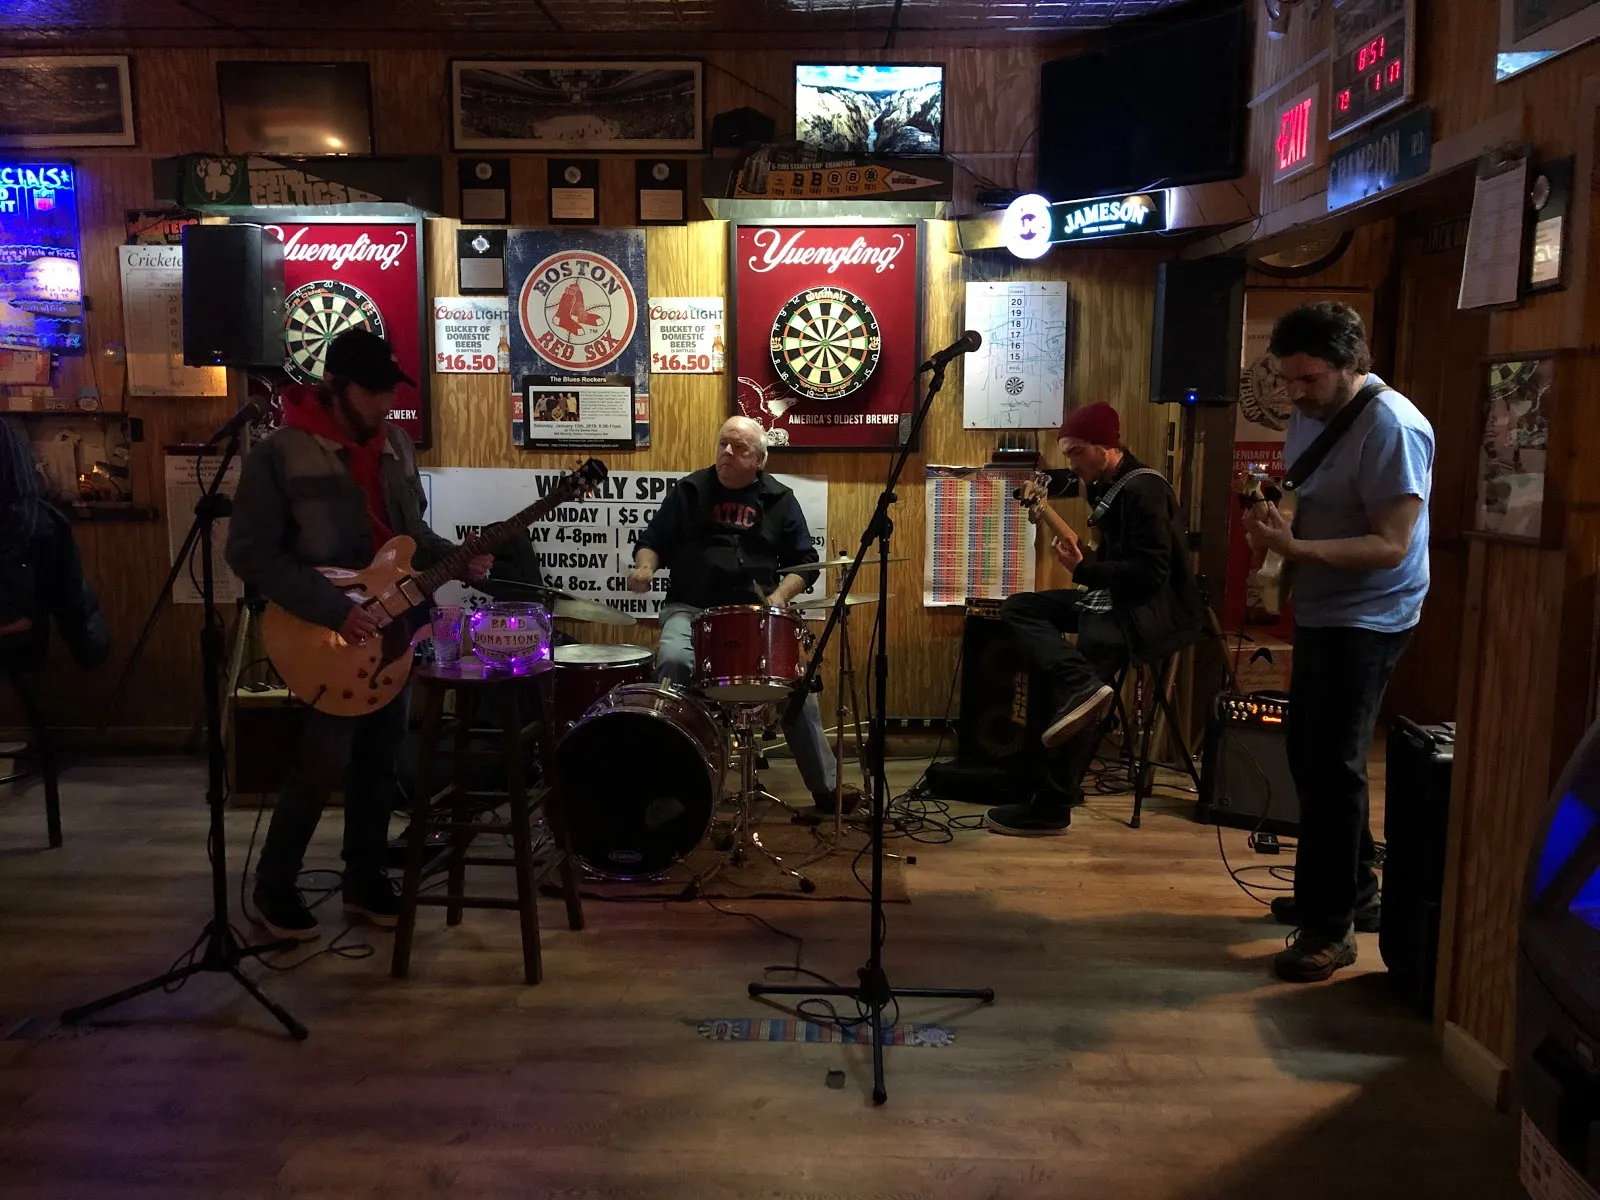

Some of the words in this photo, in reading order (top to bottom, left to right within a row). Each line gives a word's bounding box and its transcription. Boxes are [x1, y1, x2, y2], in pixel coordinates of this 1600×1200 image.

[1279, 97, 1312, 170] EXIT
[0, 167, 61, 187] CIALS
[251, 182, 349, 208] CELTICS
[1064, 201, 1148, 234] JAMESON
[533, 260, 622, 297] BOSTON
[1011, 298, 1023, 306] 20
[434, 305, 474, 321] Coors
[475, 310, 509, 320] LIGHT
[649, 305, 688, 321] Coors
[690, 310, 723, 320] LIGHT
[1011, 309, 1022, 318] 19
[445, 325, 478, 333] BUCKET
[479, 325, 491, 333] OF
[660, 325, 692, 333] BUCKET
[694, 325, 706, 333] OF
[1011, 320, 1022, 328] 18
[446, 333, 490, 341] DOMESTIC
[661, 333, 705, 341] DOMESTIC
[1010, 331, 1021, 339] 17
[455, 341, 482, 349] BEERS
[537, 330, 575, 361] RED
[583, 329, 620, 361] SOX
[670, 341, 697, 349] BEERS
[1011, 343, 1021, 351] 16
[437, 351, 496, 371] $16.50
[652, 351, 710, 371] $16.50
[1010, 353, 1021, 361] 15
[563, 376, 580, 384] Blues
[581, 376, 607, 384] Rockers
[385, 409, 417, 420] EWERY.
[788, 414, 832, 425] AMERICA'S
[834, 414, 863, 425] OLDEST
[865, 414, 899, 425] BREWER
[541, 507, 600, 523] ONDAY
[618, 507, 639, 526] $5
[555, 528, 607, 547] 4-8pm
[537, 552, 609, 569] HURSDAY
[568, 576, 602, 592] 8oz.
[606, 599, 651, 613] WHEN
[474, 633, 540, 646] DONATIONS
